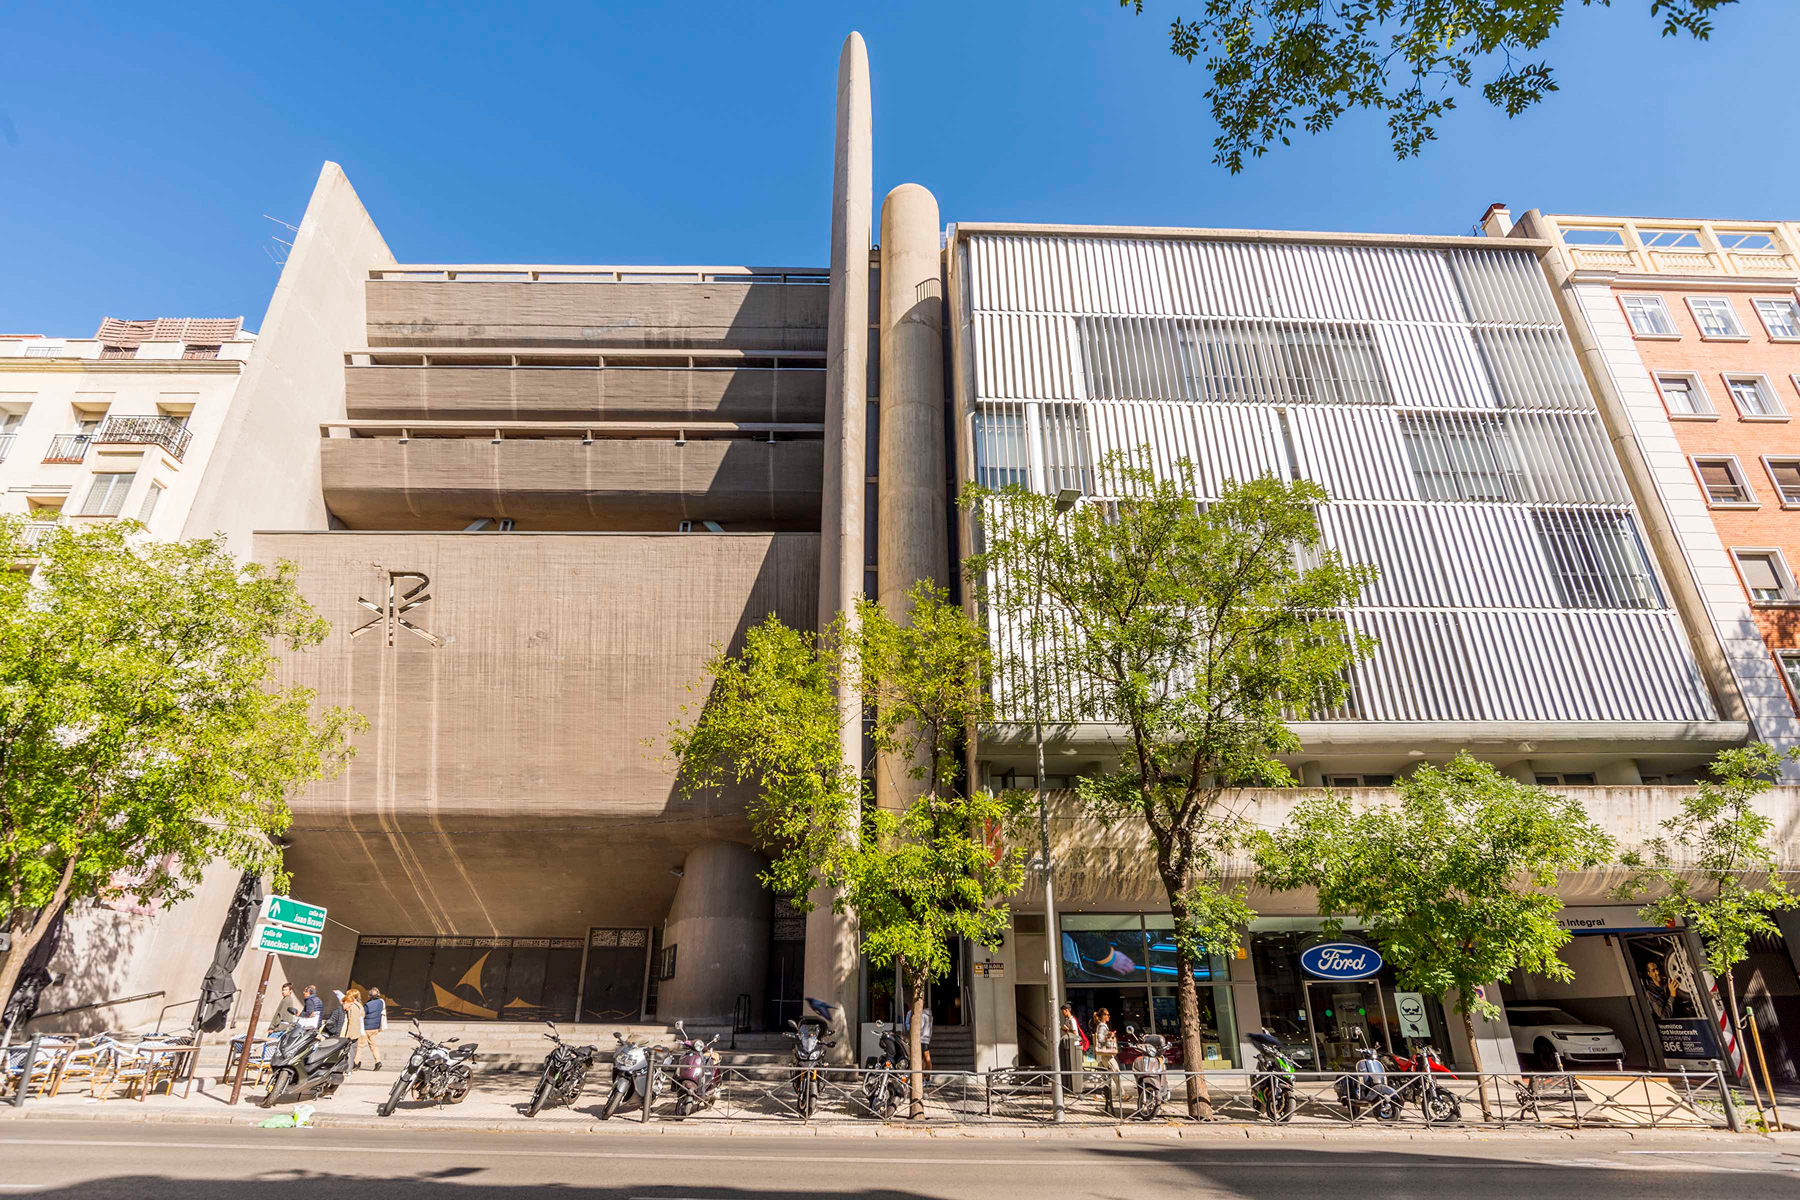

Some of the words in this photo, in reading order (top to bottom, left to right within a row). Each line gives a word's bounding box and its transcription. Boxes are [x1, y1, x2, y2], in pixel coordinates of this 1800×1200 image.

[294, 914, 307, 924] Juan
[308, 917, 323, 927] Bravo
[1566, 918, 1605, 927] Integral
[260, 937, 289, 949] Francisco
[289, 942, 308, 953] Silvela
[1318, 948, 1366, 970] Ford
